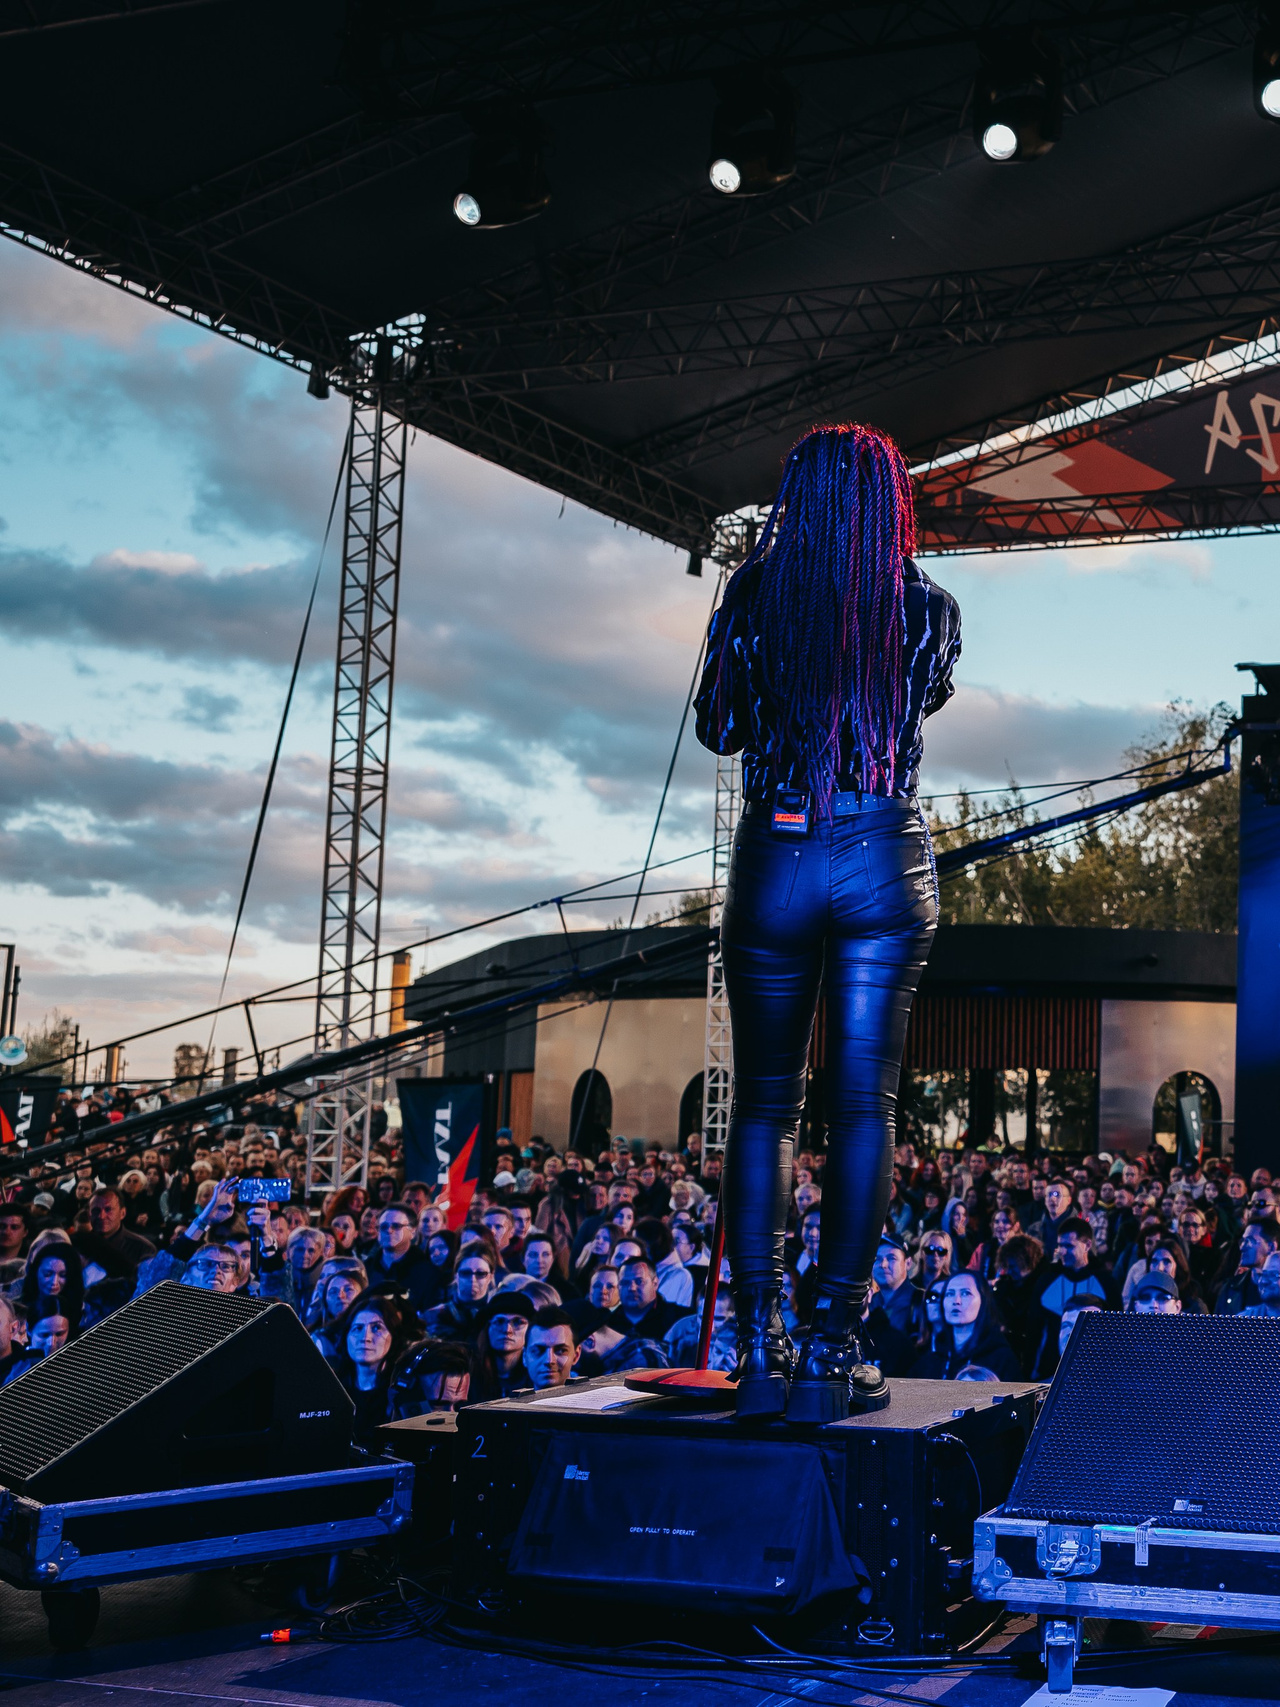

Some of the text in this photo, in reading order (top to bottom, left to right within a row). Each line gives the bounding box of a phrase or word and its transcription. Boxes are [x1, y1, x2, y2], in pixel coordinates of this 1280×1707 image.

[299, 1409, 331, 1419] MJF-210
[471, 1434, 488, 1459] 2
[629, 1526, 696, 1537] OPEN FULLY TO OPERATE
